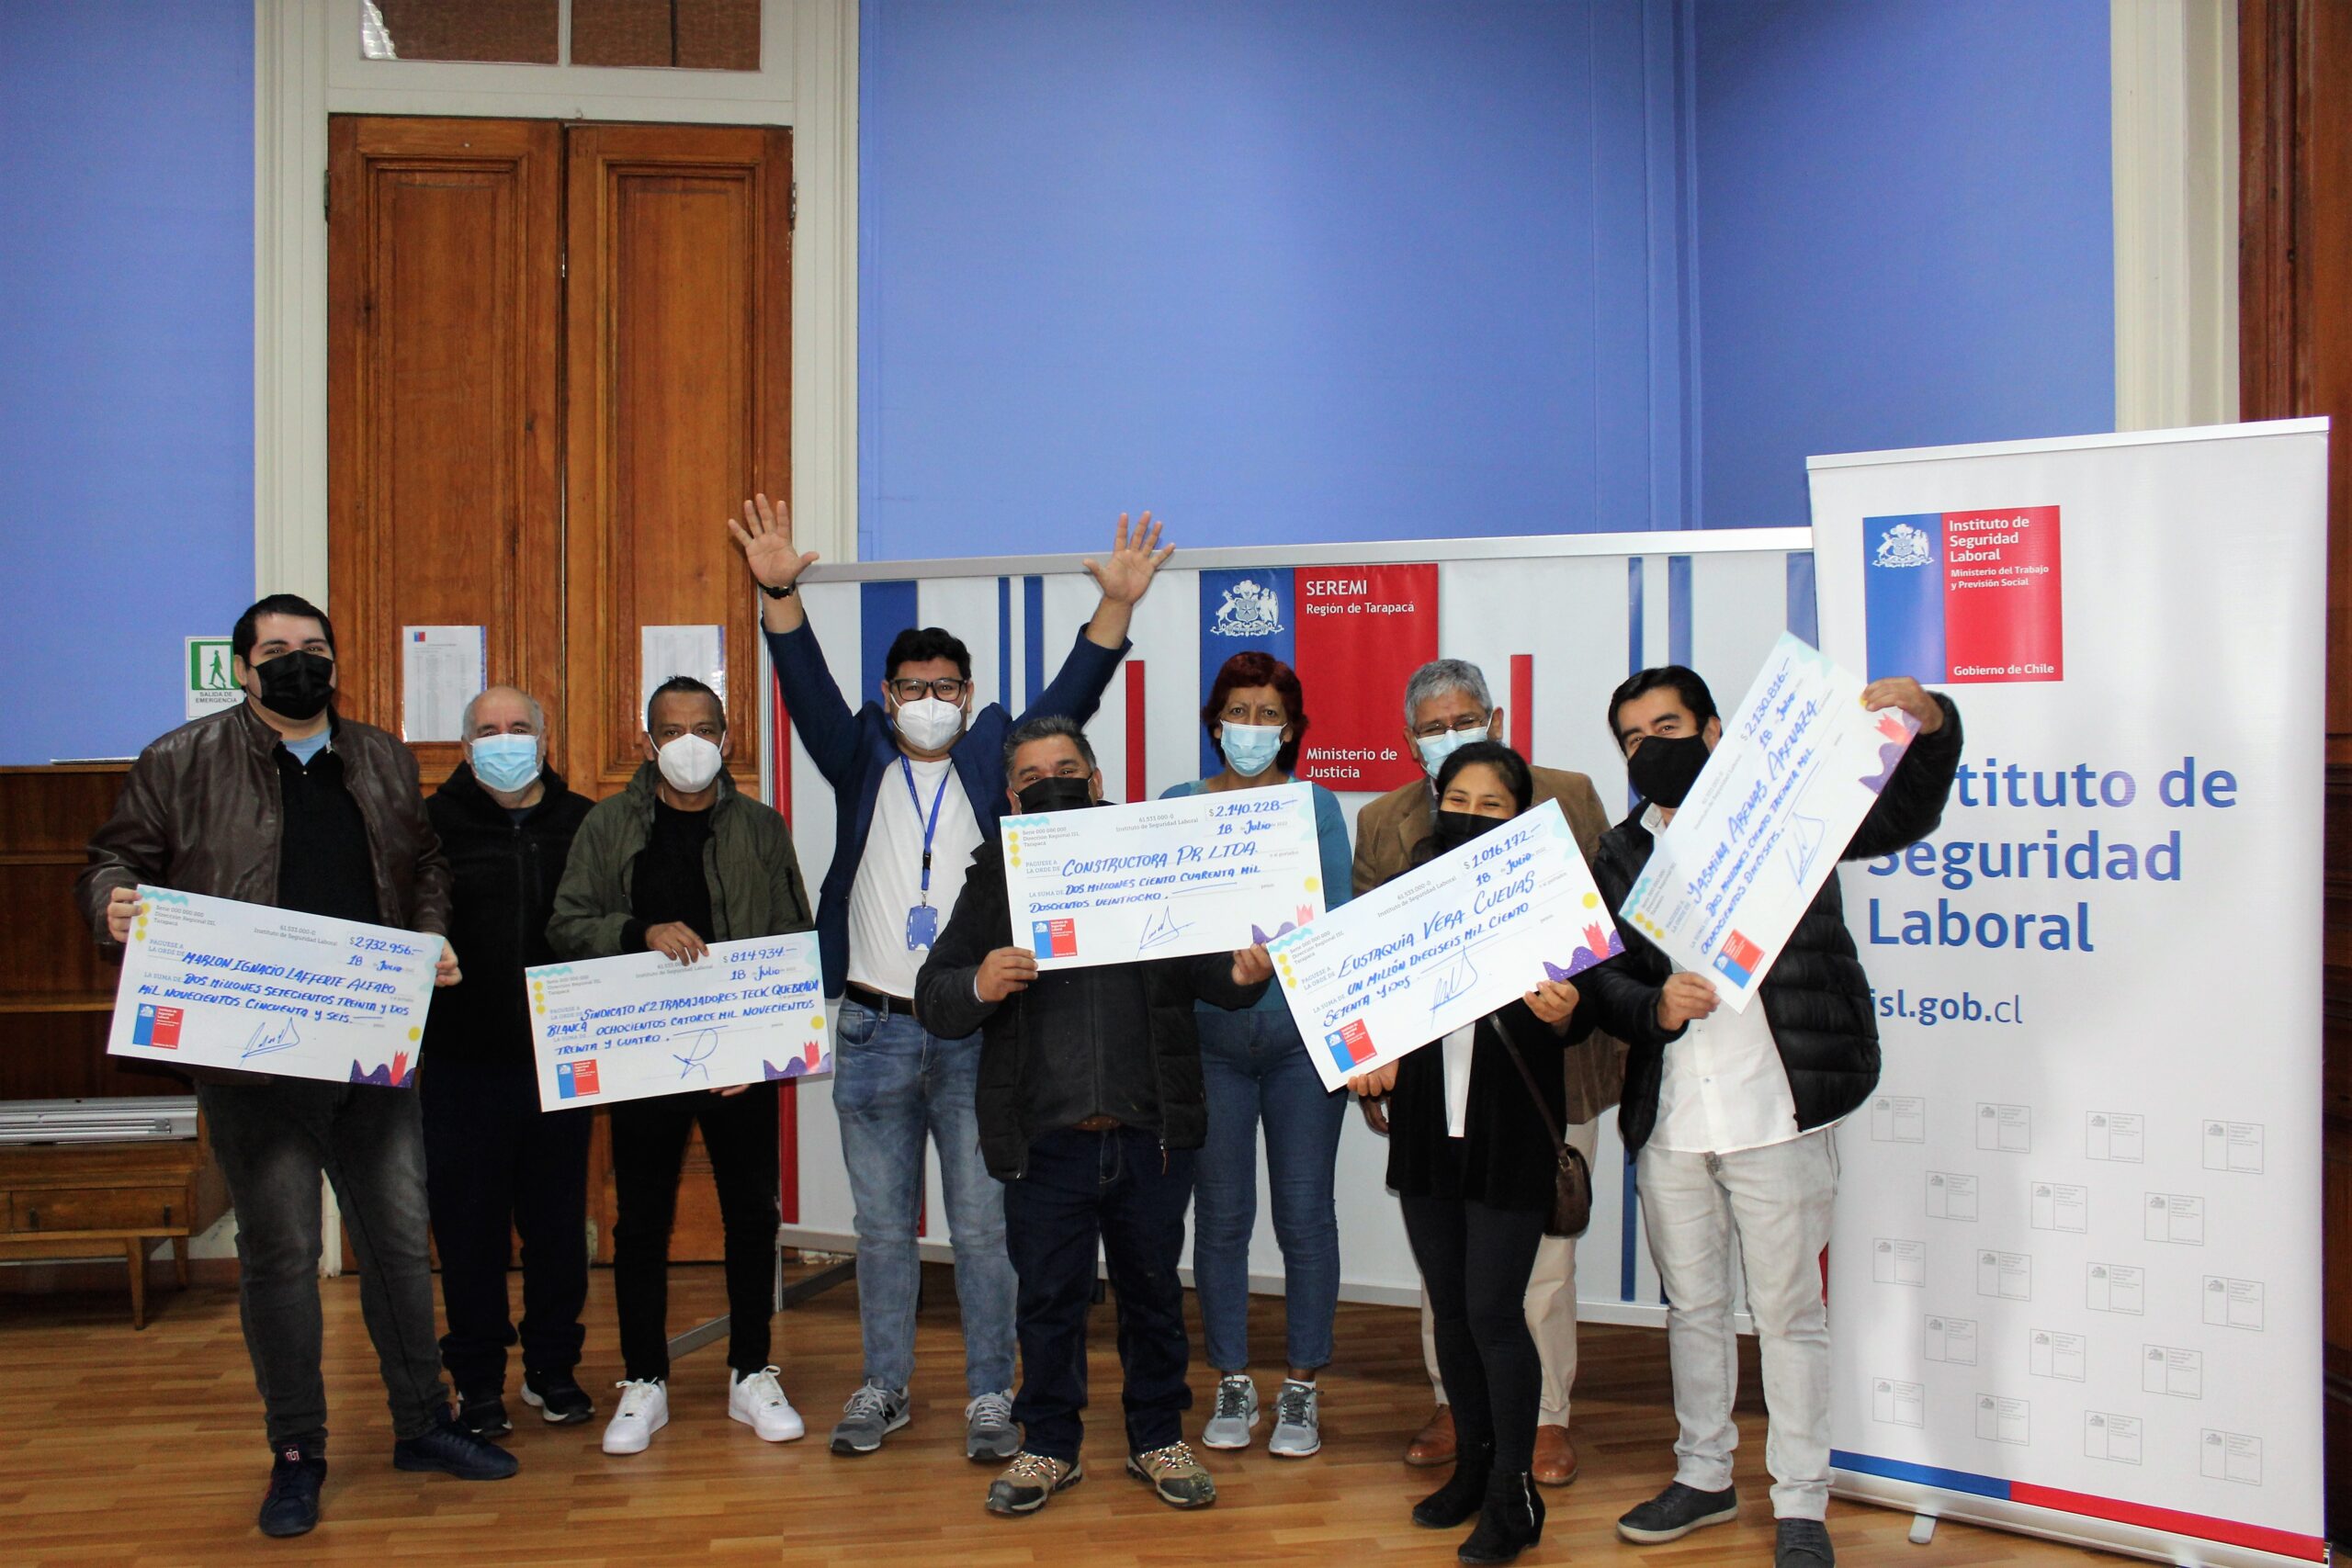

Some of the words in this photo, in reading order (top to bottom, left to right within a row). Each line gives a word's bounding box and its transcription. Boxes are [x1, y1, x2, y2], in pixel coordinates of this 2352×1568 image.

[1950, 518, 2008, 532] Instituto
[2012, 516, 2030, 527] de
[1950, 533, 2019, 549] Seguridad
[1950, 548, 2001, 562] Laboral
[1951, 568, 1996, 577] Ministerio
[1998, 567, 2012, 575] del
[2015, 565, 2049, 575] Trabajo
[1306, 580, 1367, 595] SEREMI
[1951, 582, 1957, 591] y
[1959, 579, 1999, 588] Previsión
[2001, 578, 2029, 586] Social
[1306, 603, 1343, 617] Región
[1347, 603, 1362, 614] de
[1364, 601, 1415, 615] Tarapacá
[1953, 665, 2004, 676] Gobierno
[2007, 665, 2021, 674] de
[2024, 663, 2054, 673] Chile
[1759, 729, 1772, 750] 18
[1306, 748, 1375, 761] Ministerio
[1380, 748, 1397, 761] de
[1306, 766, 1360, 778] Justicia
[1954, 757, 2136, 808] tituto
[2159, 757, 2238, 808] de
[1148, 819, 1176, 829] Seguridad
[1216, 823, 1232, 834] 18
[1062, 852, 1168, 876] CONSTRUCTORA
[1176, 845, 1203, 865] PR
[1476, 872, 1490, 886] 18
[1065, 884, 1083, 895] DOS
[1377, 902, 1401, 918] Instituto
[1408, 886, 1436, 904] Seguridad
[1435, 874, 1457, 889] Laboral
[1338, 932, 1414, 977] EUSTAQUIA
[1423, 909, 1464, 939] VERA
[1473, 870, 1534, 914] CUEVAS
[1869, 898, 2094, 952] Laboral
[346, 954, 362, 965] 18
[182, 952, 232, 967] MARLON
[286, 967, 345, 987] LAFFERTE
[346, 978, 395, 993] ALFARO
[729, 969, 745, 979] 18
[183, 973, 208, 985] DOS
[390, 1005, 408, 1015] DOS
[741, 987, 769, 998] TECK
[771, 978, 819, 995] QUEBRADA
[1347, 980, 1363, 995] UN
[1870, 988, 2023, 1026] isl.gob.cl
[547, 1020, 586, 1036] BLANCA
[742, 999, 814, 1016] NOVECIENTOS
